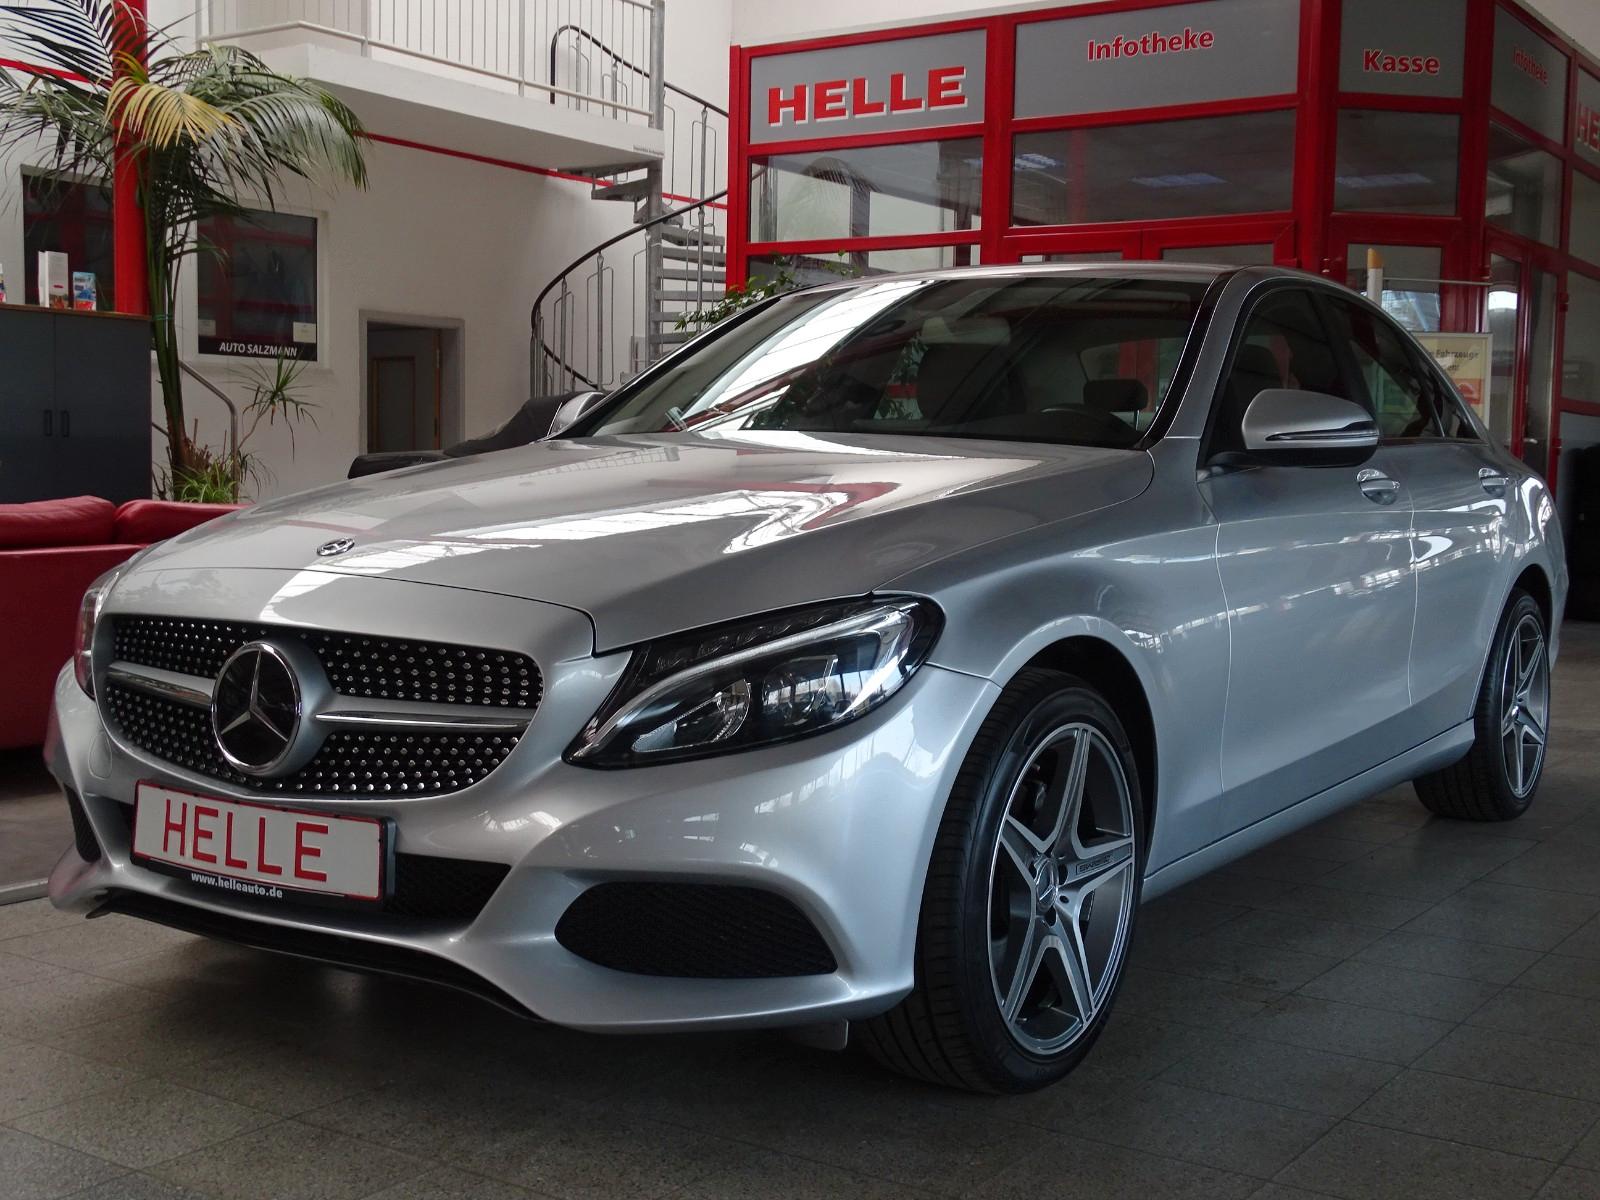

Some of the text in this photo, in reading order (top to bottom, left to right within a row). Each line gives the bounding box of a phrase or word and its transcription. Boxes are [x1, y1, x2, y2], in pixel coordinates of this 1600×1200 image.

[1088, 27, 1215, 61] Infotheke
[1363, 48, 1440, 75] Kasse
[769, 66, 968, 127] HELLE
[219, 342, 298, 357] AUTO SALZMANN
[163, 799, 329, 882] HELLE
[191, 872, 283, 898] www.helleauto.de
